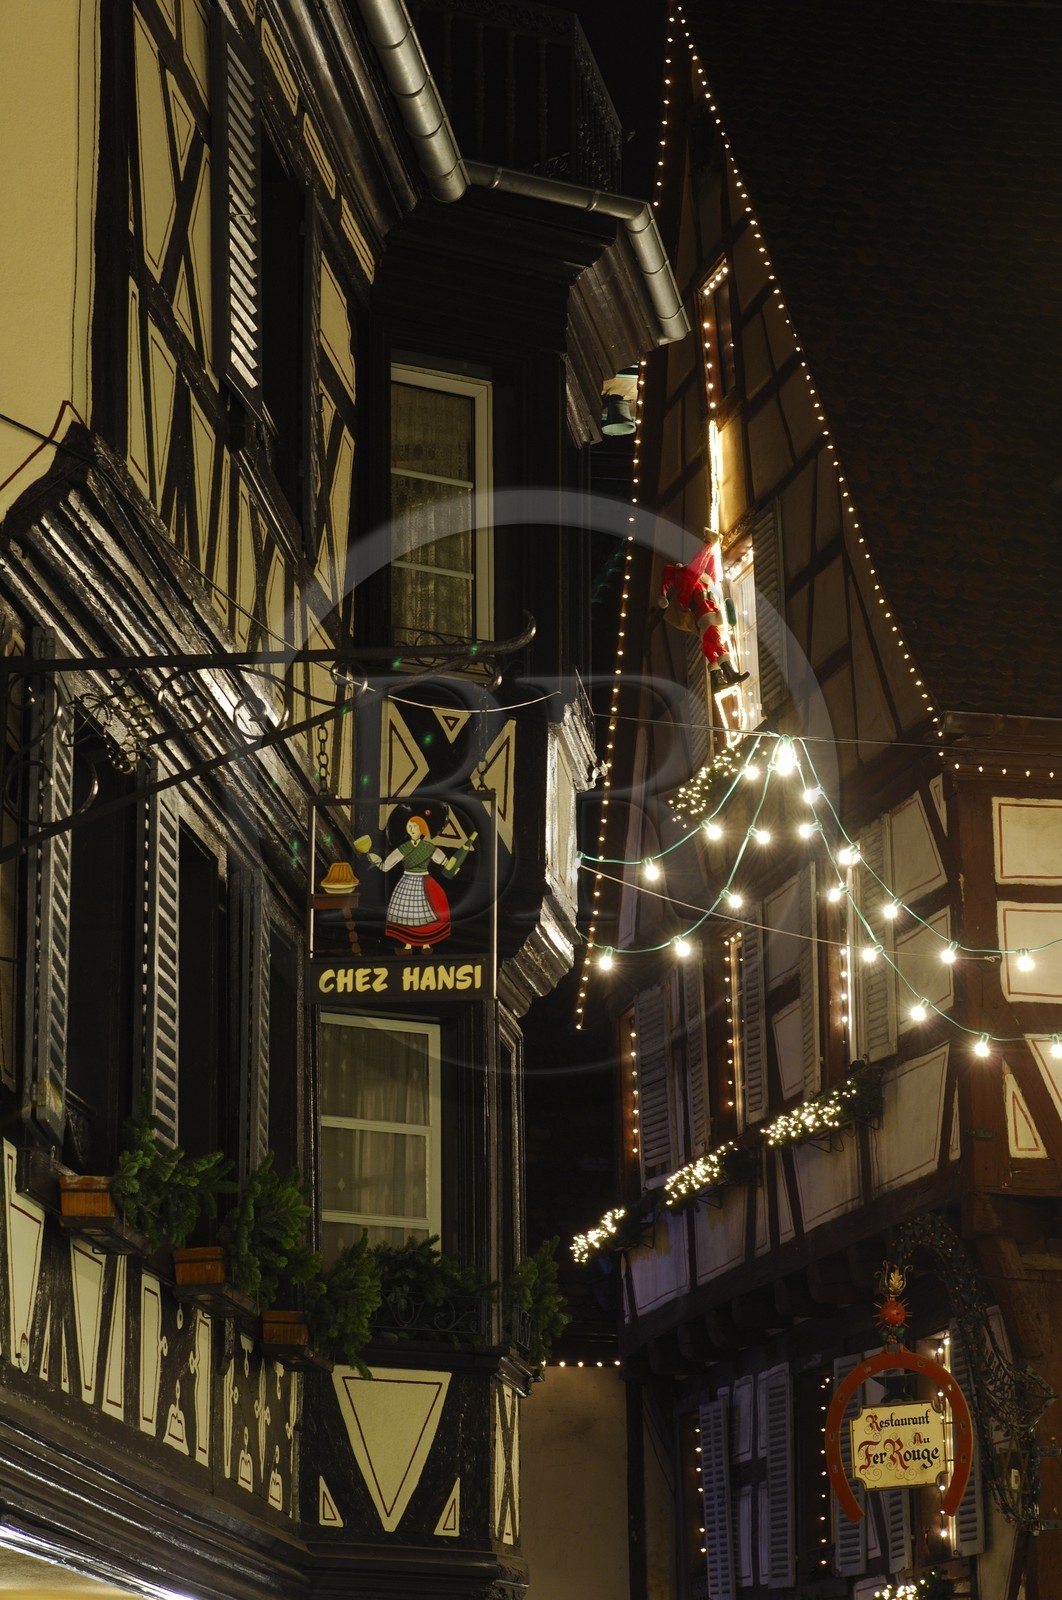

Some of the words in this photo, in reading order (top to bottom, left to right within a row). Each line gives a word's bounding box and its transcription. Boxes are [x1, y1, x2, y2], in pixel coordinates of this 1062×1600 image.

[318, 967, 389, 993] CHEZ
[402, 964, 482, 991] HANSI
[865, 1409, 931, 1432] Restaurant
[912, 1432, 930, 1445] Au
[858, 1440, 887, 1472] Fer
[883, 1438, 940, 1470] Rouge
